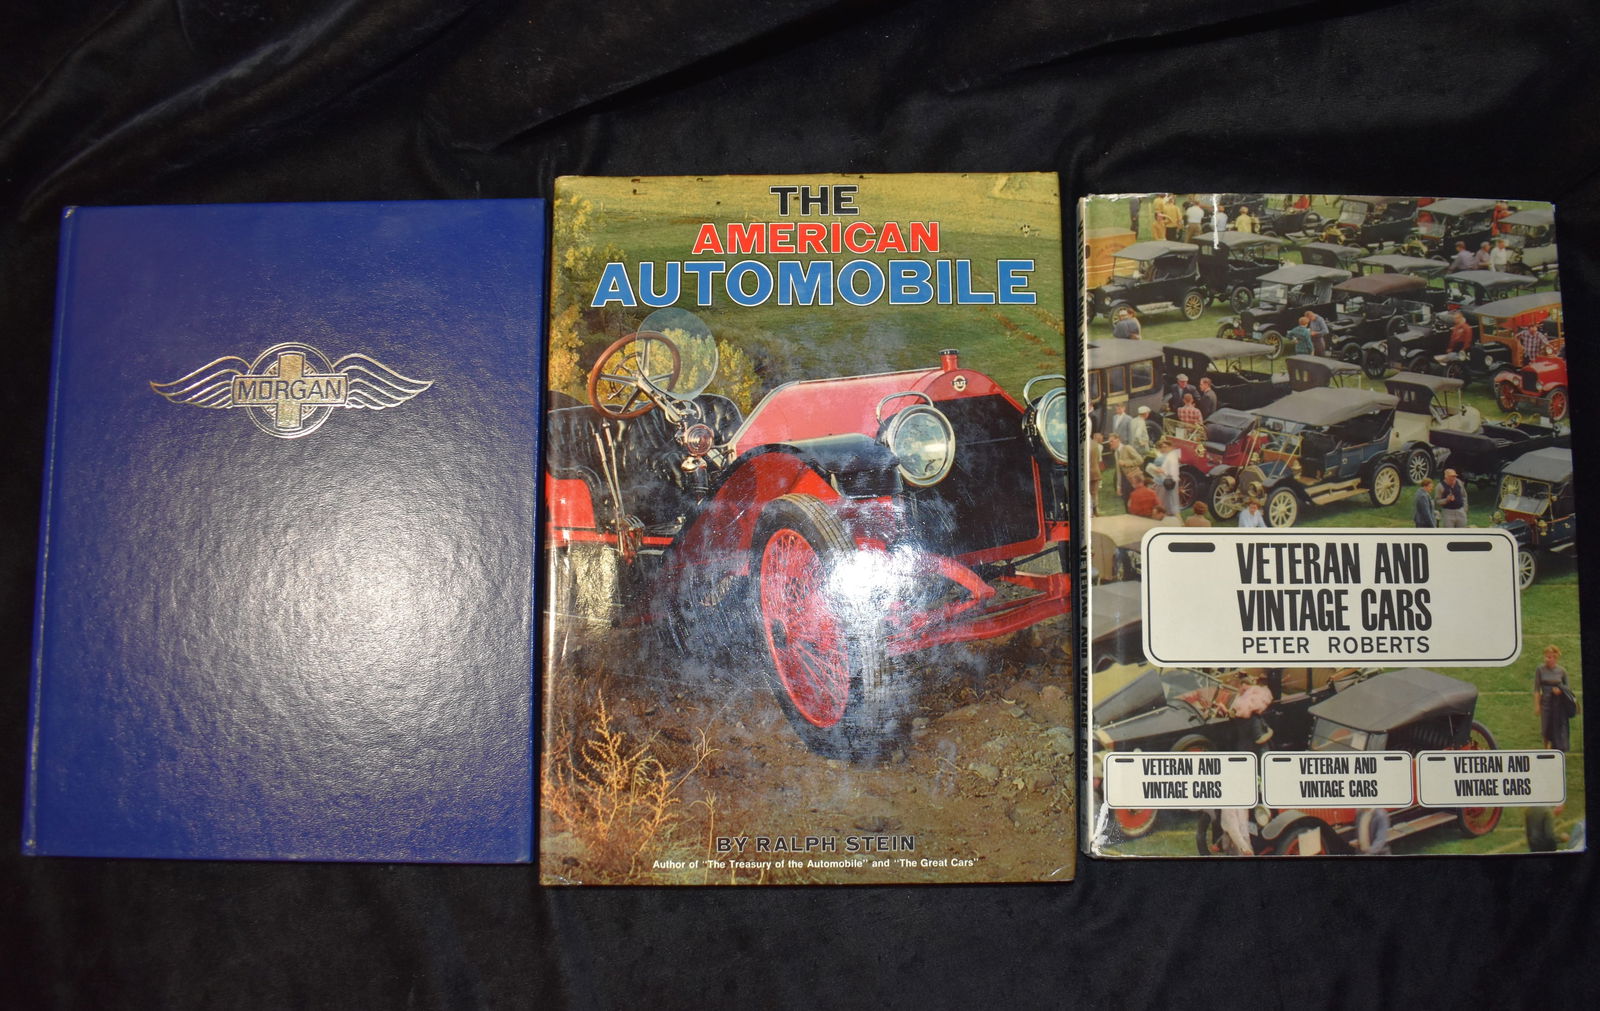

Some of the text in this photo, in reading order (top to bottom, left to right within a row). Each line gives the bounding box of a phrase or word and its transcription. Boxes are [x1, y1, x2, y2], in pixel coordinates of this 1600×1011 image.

[770, 185, 859, 216] THE
[691, 221, 940, 255] AMERICAN
[590, 259, 1038, 308] AUTOMOBILE
[237, 379, 342, 400] MORGAN
[1236, 542, 1430, 584] VETERAN AND
[1236, 588, 1432, 632] VINTAGE CARS
[1242, 636, 1430, 654] PETER ROBERTS
[1142, 758, 1221, 776] VETERAN AND
[1299, 757, 1377, 775] VETERAN AND
[1454, 755, 1530, 774] VETERAN AND
[1142, 780, 1222, 799] VINTAGE CARS
[1299, 780, 1378, 798] VINTAGE CARS
[1454, 778, 1531, 797] VINTAGE CARS
[716, 836, 915, 852] BY RALPH STEIN
[653, 860, 685, 869] Author
[689, 860, 699, 869] of
[729, 859, 772, 871] Treasury
[775, 860, 786, 869] of
[788, 860, 804, 869] the
[872, 858, 890, 868] and
[920, 858, 948, 868] Great
